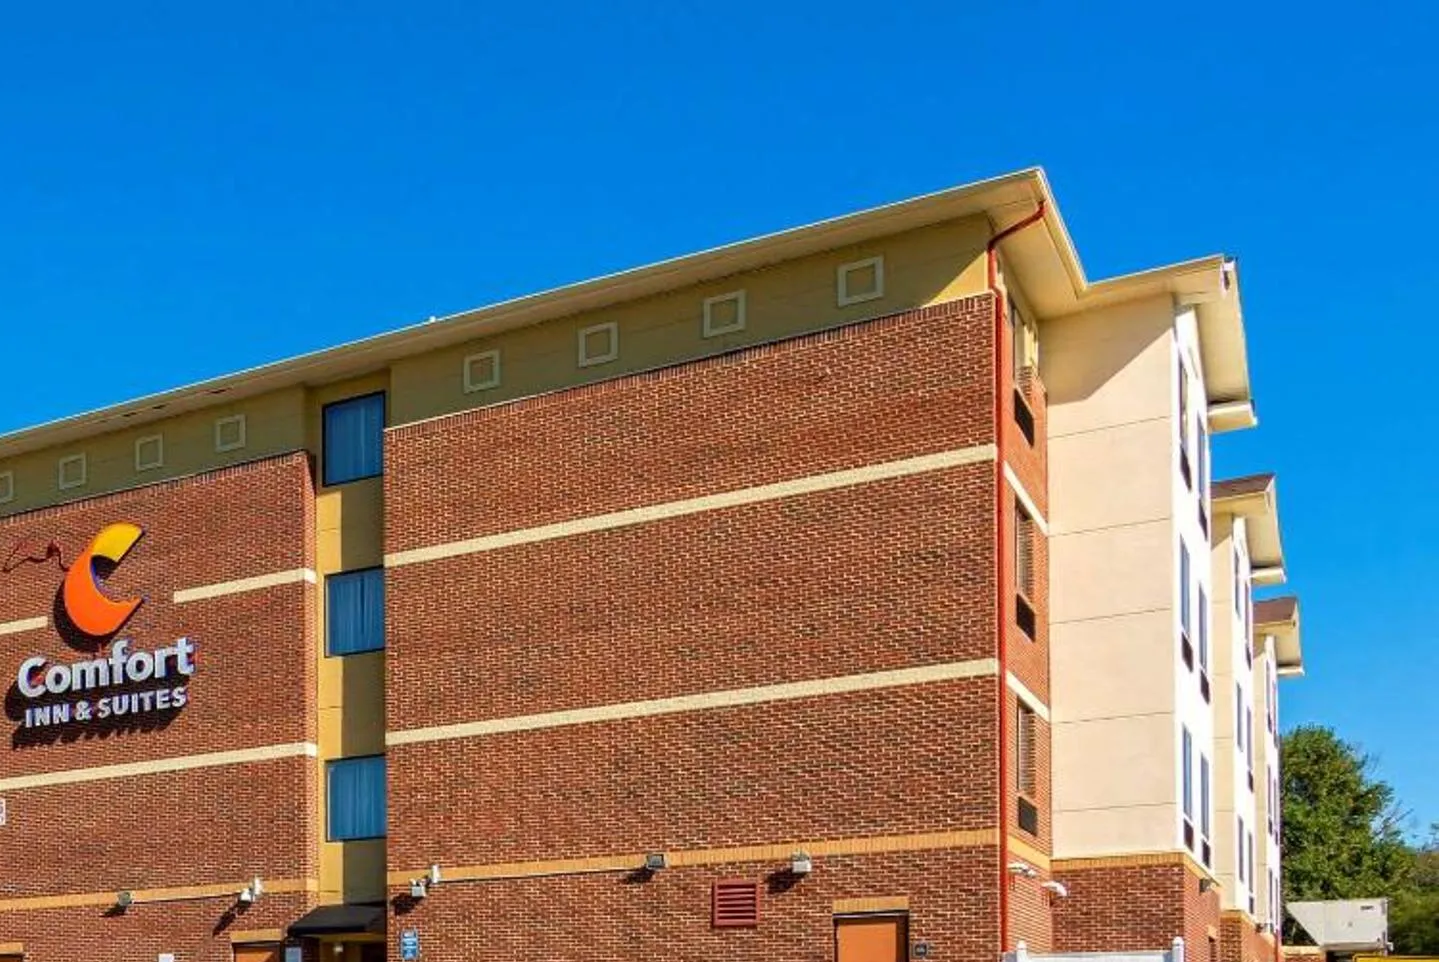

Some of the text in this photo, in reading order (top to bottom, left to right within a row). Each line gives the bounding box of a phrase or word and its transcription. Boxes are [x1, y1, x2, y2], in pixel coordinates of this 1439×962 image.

[17, 636, 195, 698] Comfort
[24, 685, 188, 729] INN & SUITES
